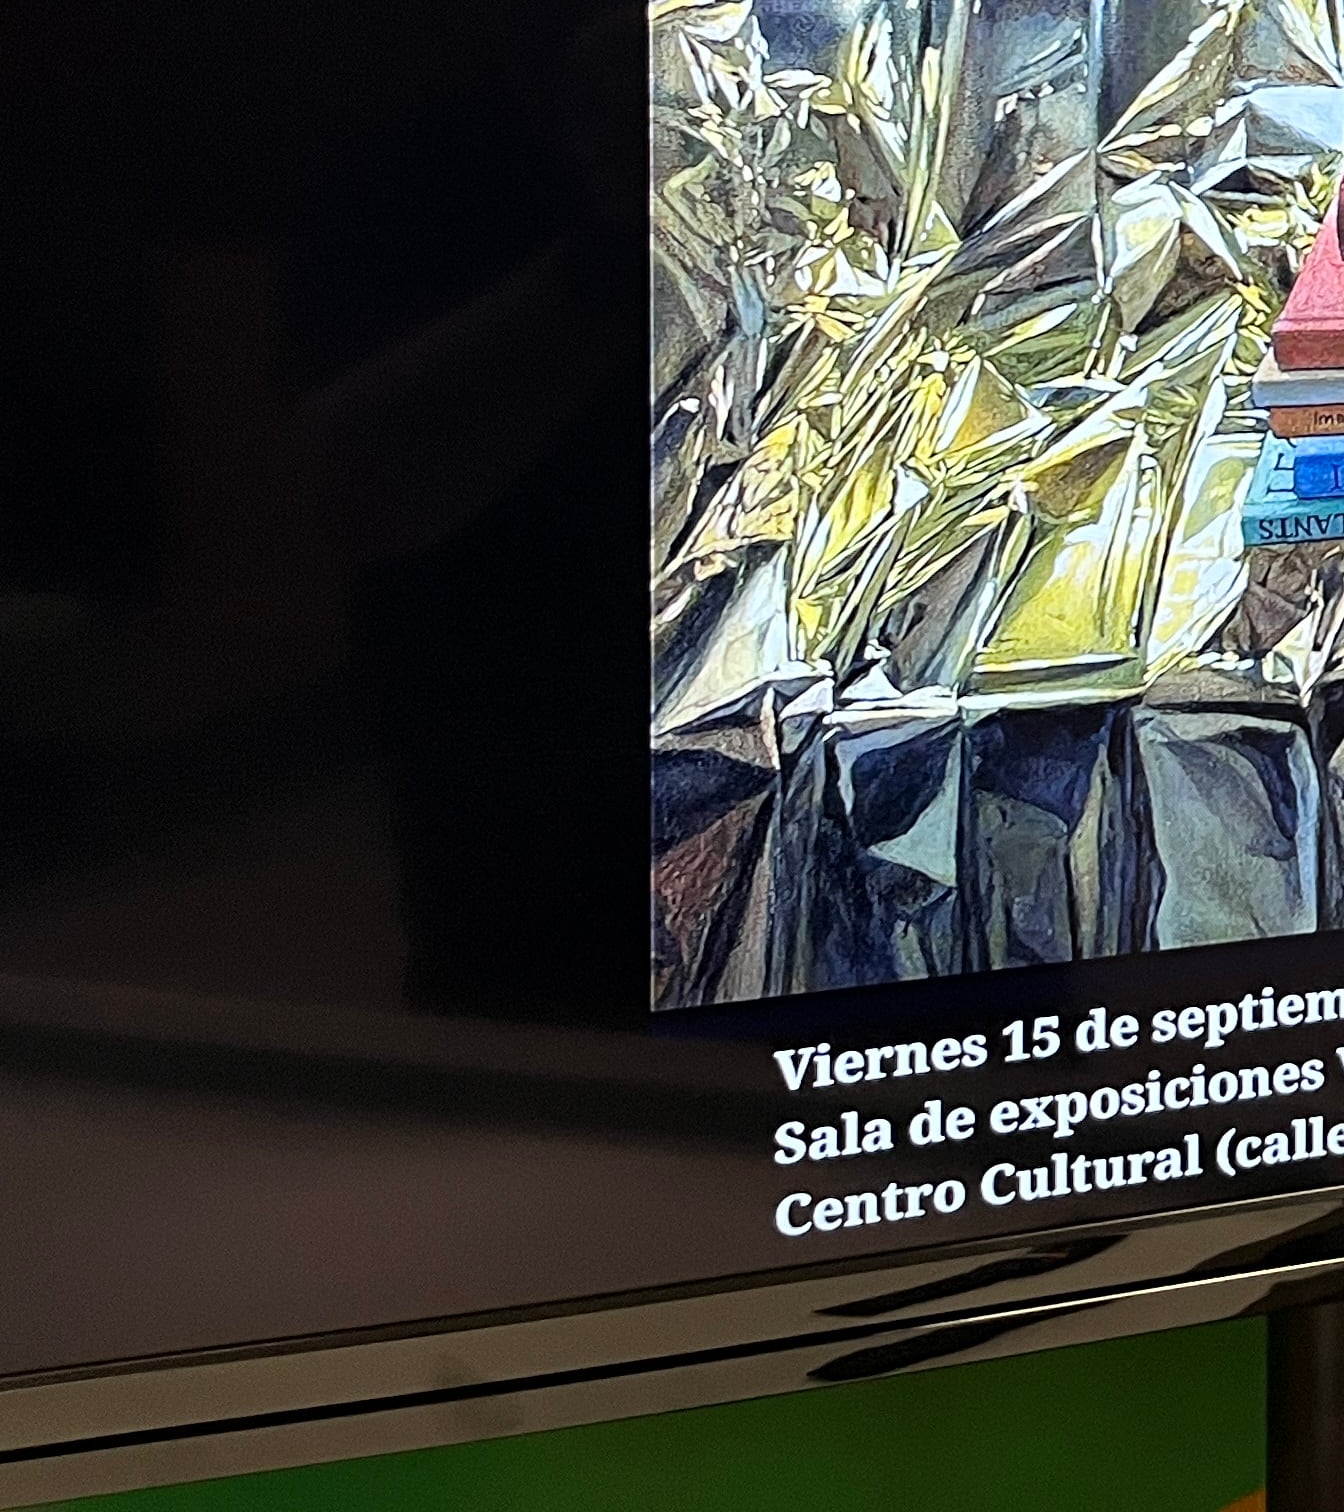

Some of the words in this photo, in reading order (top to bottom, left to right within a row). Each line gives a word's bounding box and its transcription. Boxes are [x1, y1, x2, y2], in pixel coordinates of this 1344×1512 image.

[772, 1034, 988, 1092] Viernes
[1002, 1015, 1061, 1063] 15
[1075, 1006, 1140, 1053] de
[774, 1110, 894, 1165] Sala
[908, 1099, 976, 1146] de
[989, 1054, 1325, 1139] exposiciones
[775, 1179, 966, 1237] Centro
[980, 1133, 1204, 1206] Cultural
